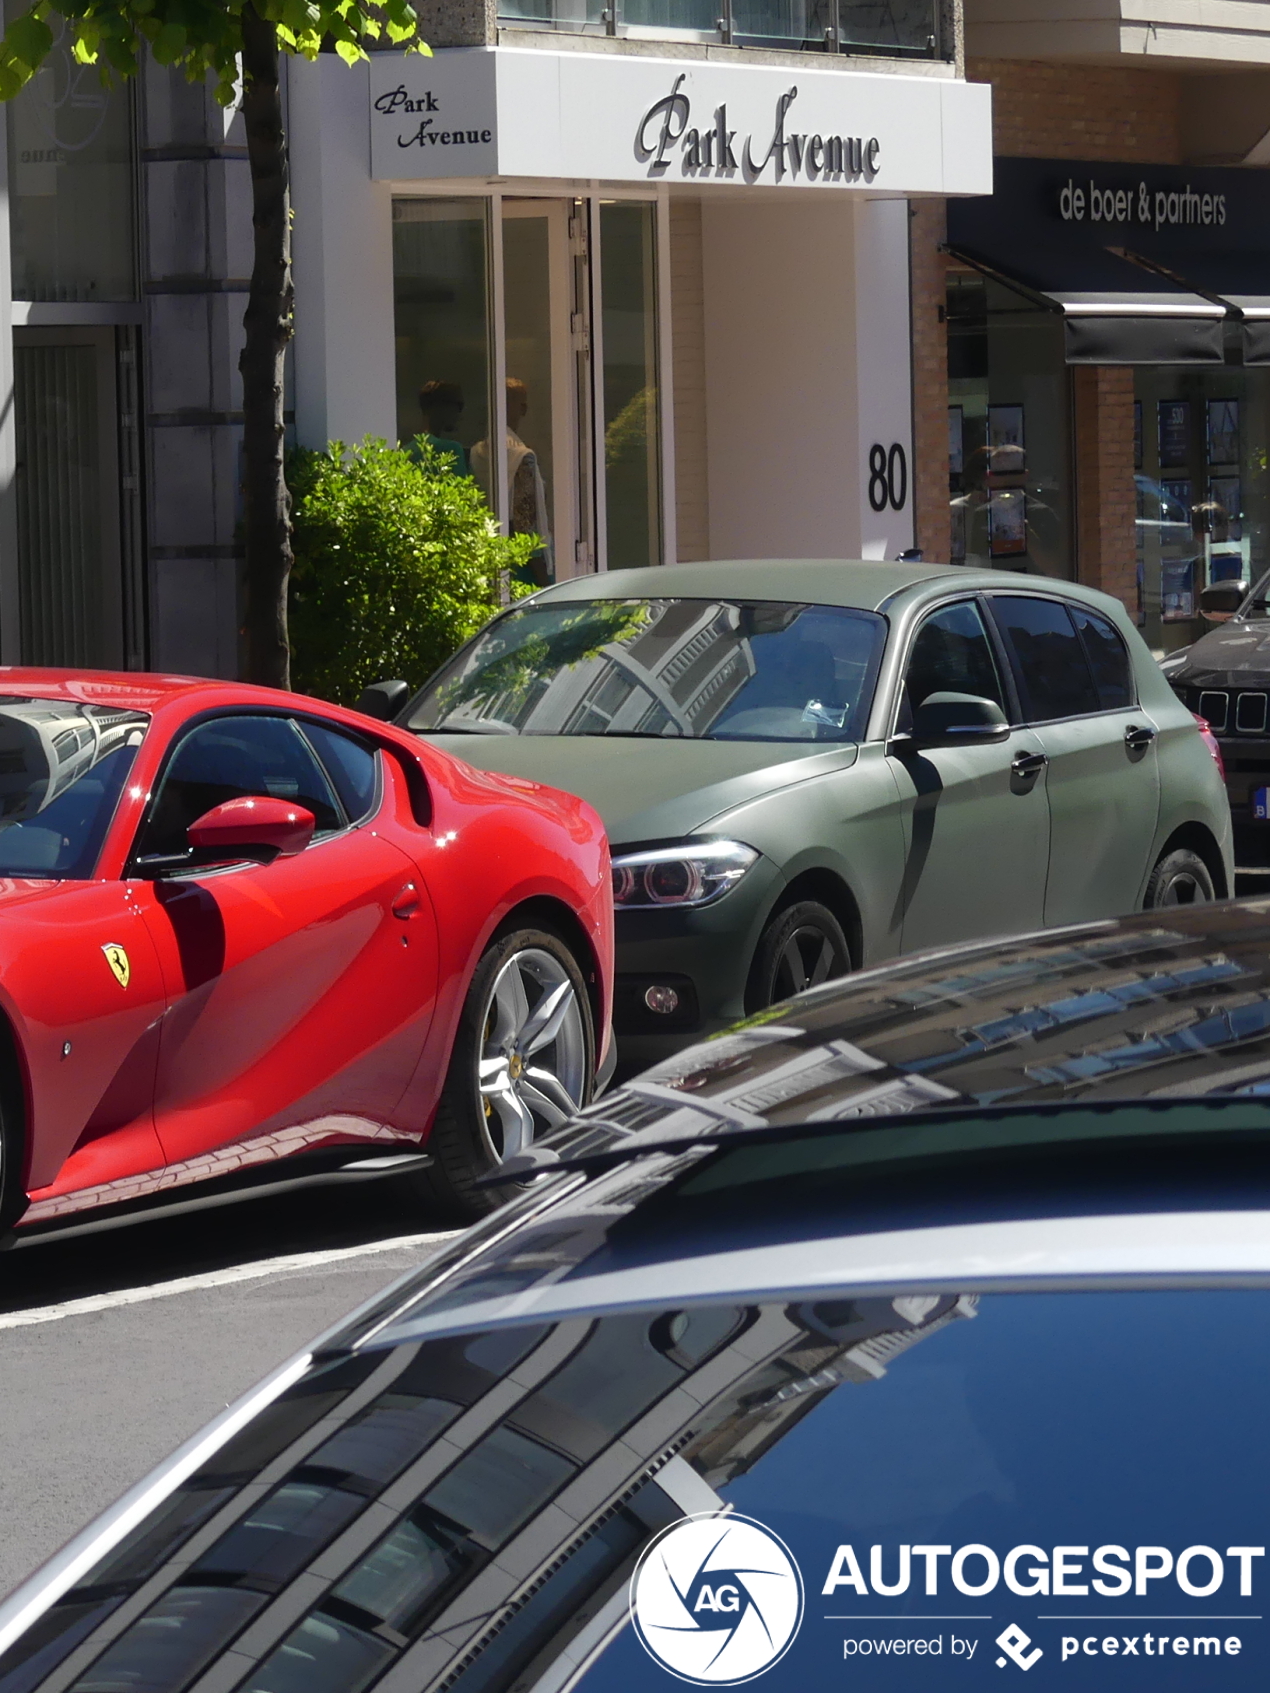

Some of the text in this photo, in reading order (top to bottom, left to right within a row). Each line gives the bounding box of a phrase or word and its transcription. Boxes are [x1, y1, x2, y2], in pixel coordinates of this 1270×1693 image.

[374, 84, 439, 115] Park
[638, 73, 881, 176] Park Avenue
[397, 118, 492, 148] Avenue
[1060, 178, 1226, 232] de boer & partners
[868, 442, 907, 512] 80
